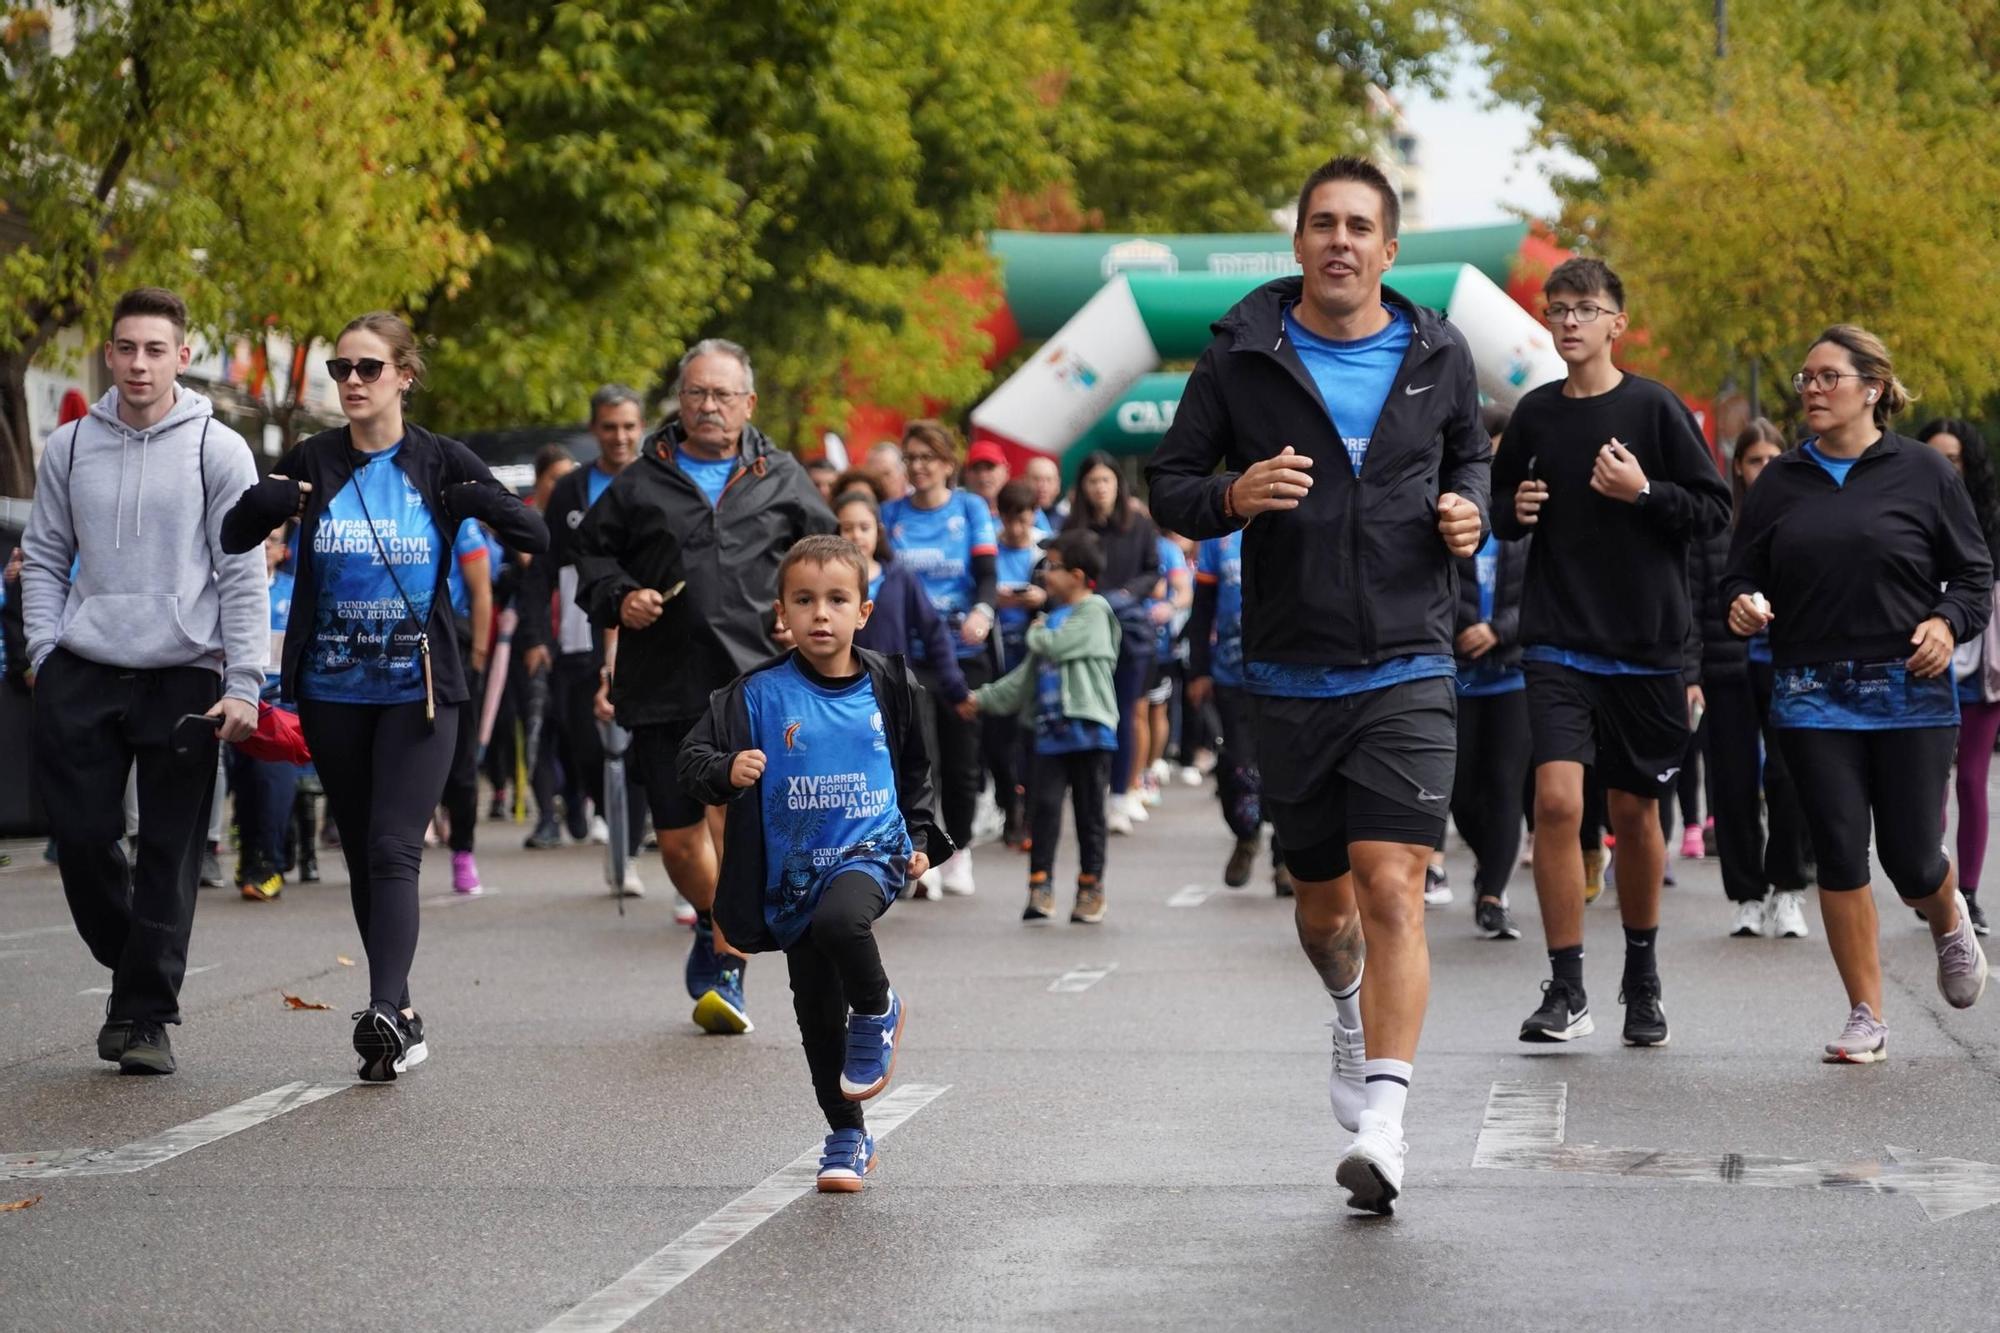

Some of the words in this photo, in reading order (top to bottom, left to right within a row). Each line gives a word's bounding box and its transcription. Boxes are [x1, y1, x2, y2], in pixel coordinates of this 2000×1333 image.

[315, 519, 346, 538] XIV
[313, 537, 386, 554] GUARDIA
[389, 536, 431, 553] CIVIL
[337, 609, 364, 619] CAJA
[367, 609, 406, 620] RURAL
[357, 632, 387, 643] feder
[787, 775, 819, 796] XIV
[819, 772, 866, 785] CARRERA
[820, 782, 867, 794] POPULAR
[787, 793, 858, 811] GUARDIA
